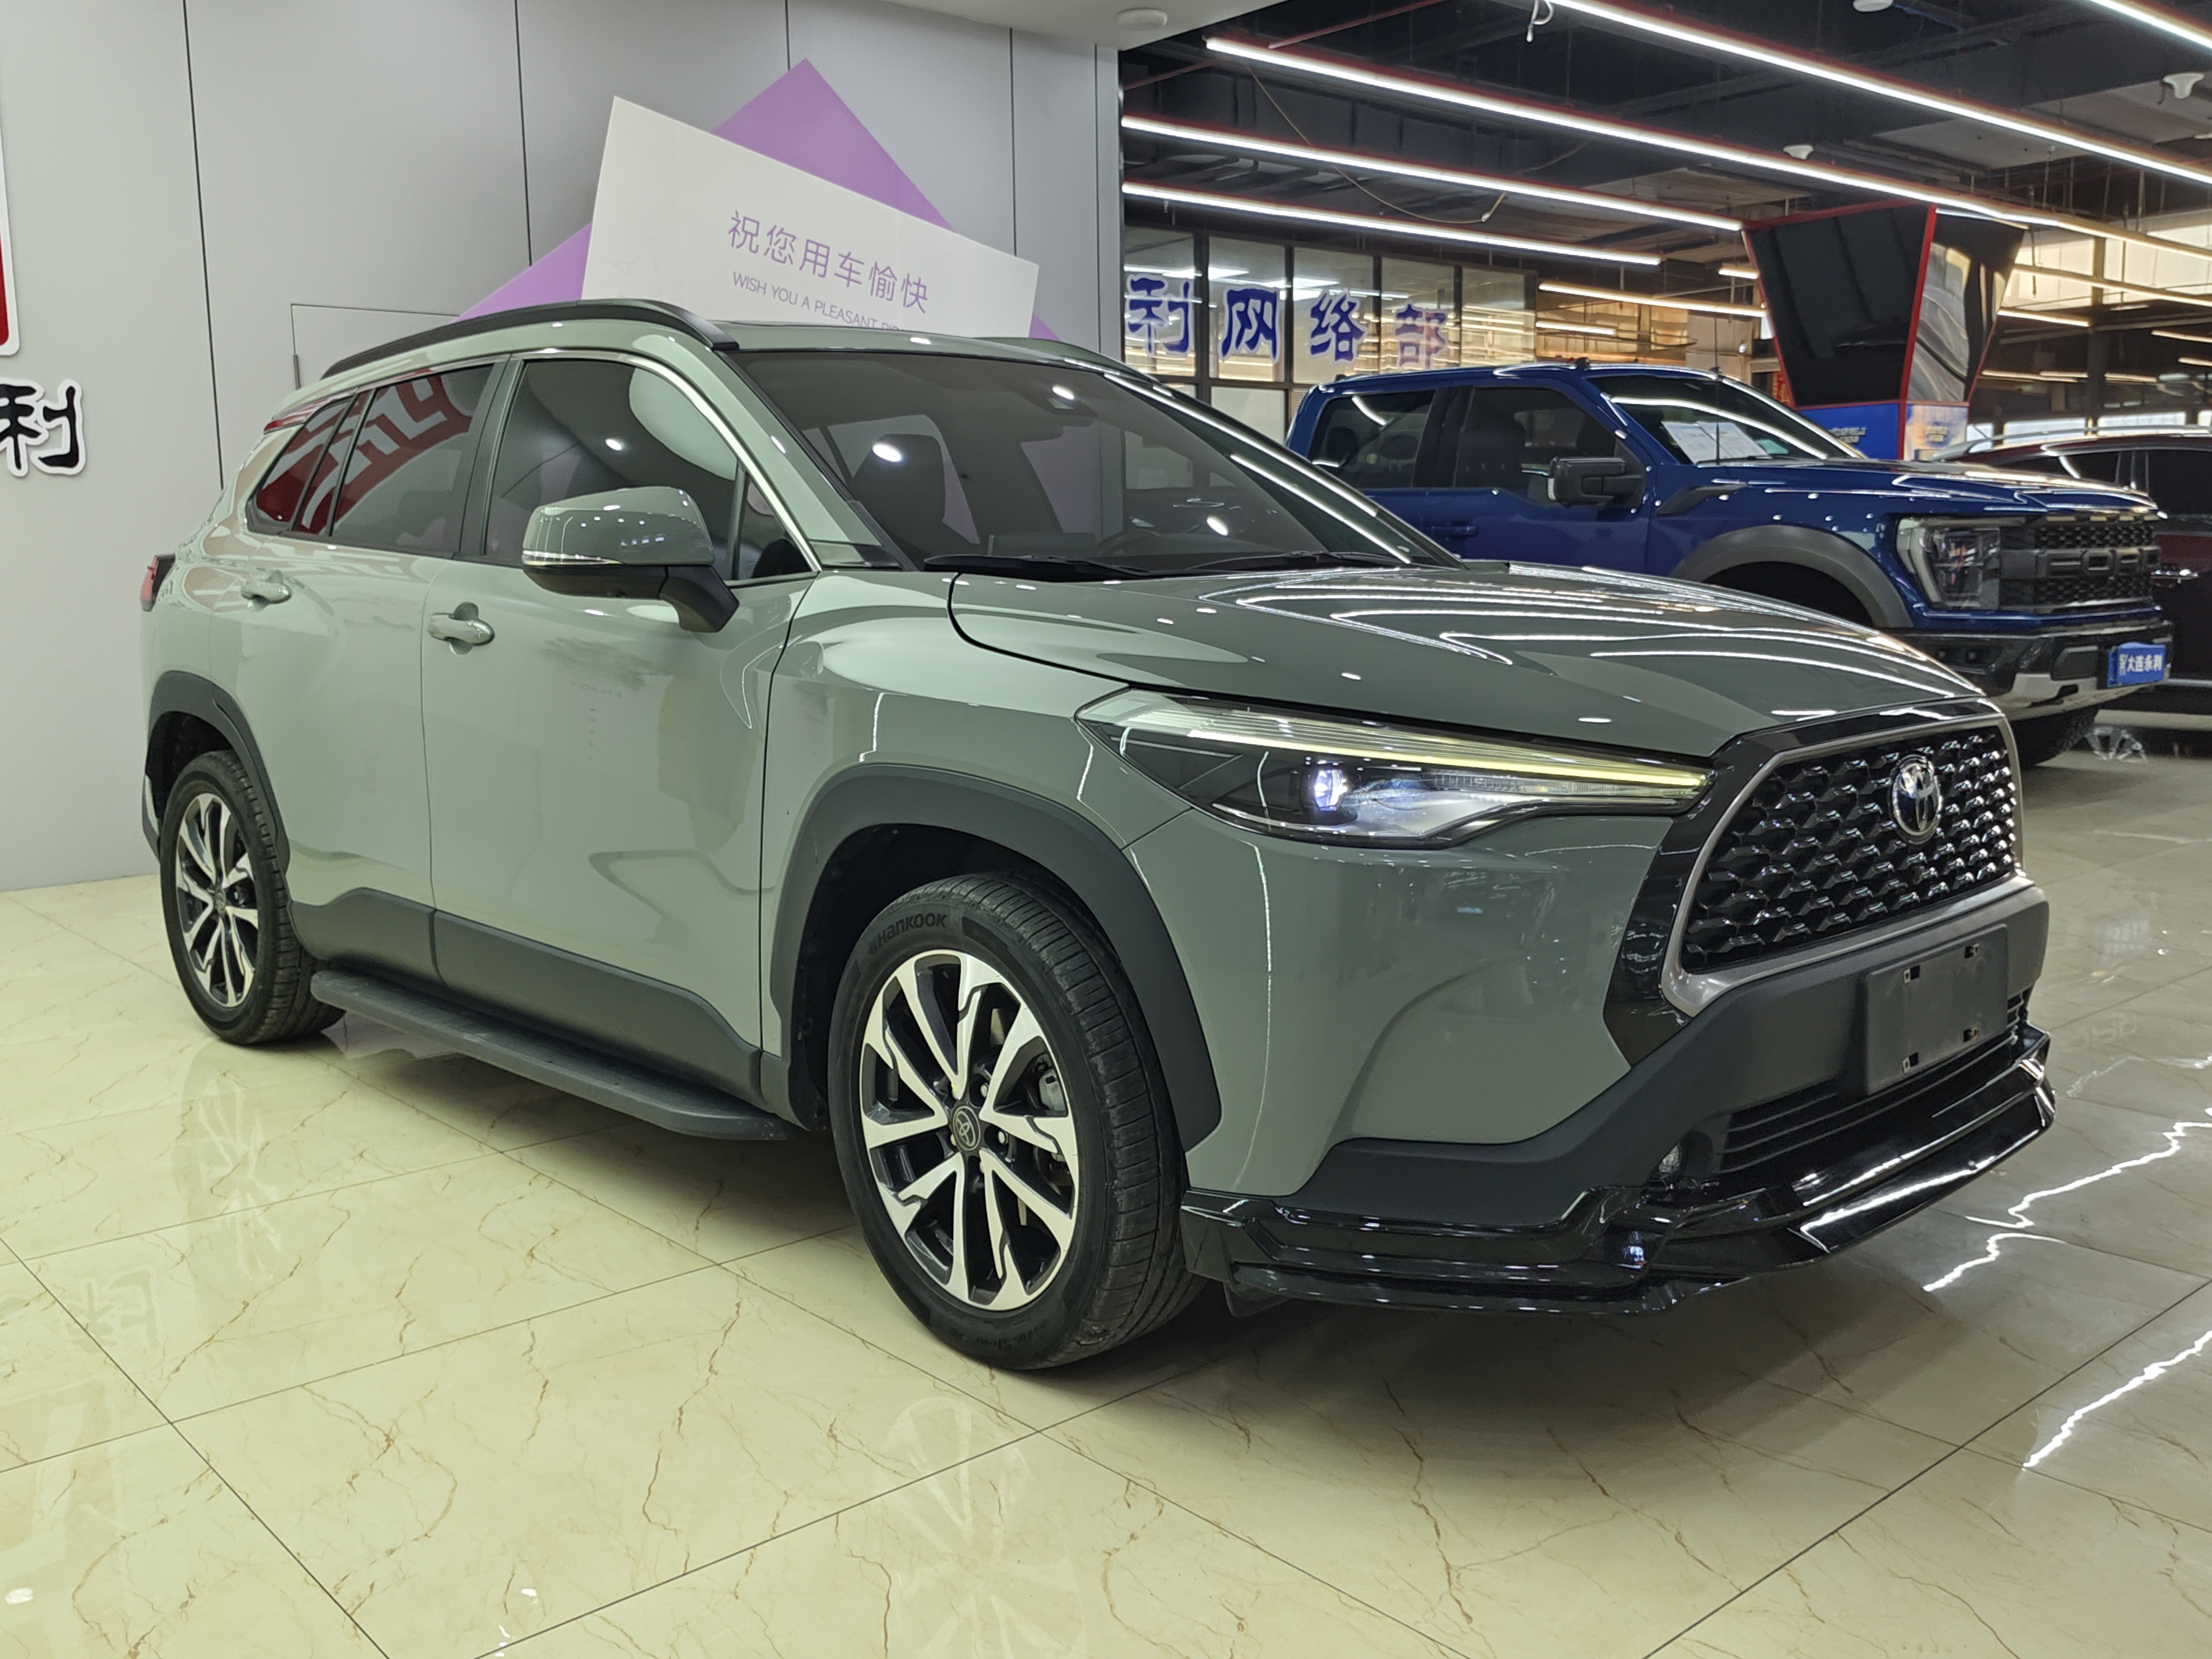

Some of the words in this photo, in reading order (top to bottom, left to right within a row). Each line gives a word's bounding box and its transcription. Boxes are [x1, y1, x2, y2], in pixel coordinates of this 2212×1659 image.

[728, 211, 928, 314] 祝您用车愉快
[734, 272, 767, 295] WISH
[771, 285, 798, 305] YOU
[801, 297, 810, 310] A
[814, 300, 878, 327] PLEASANT
